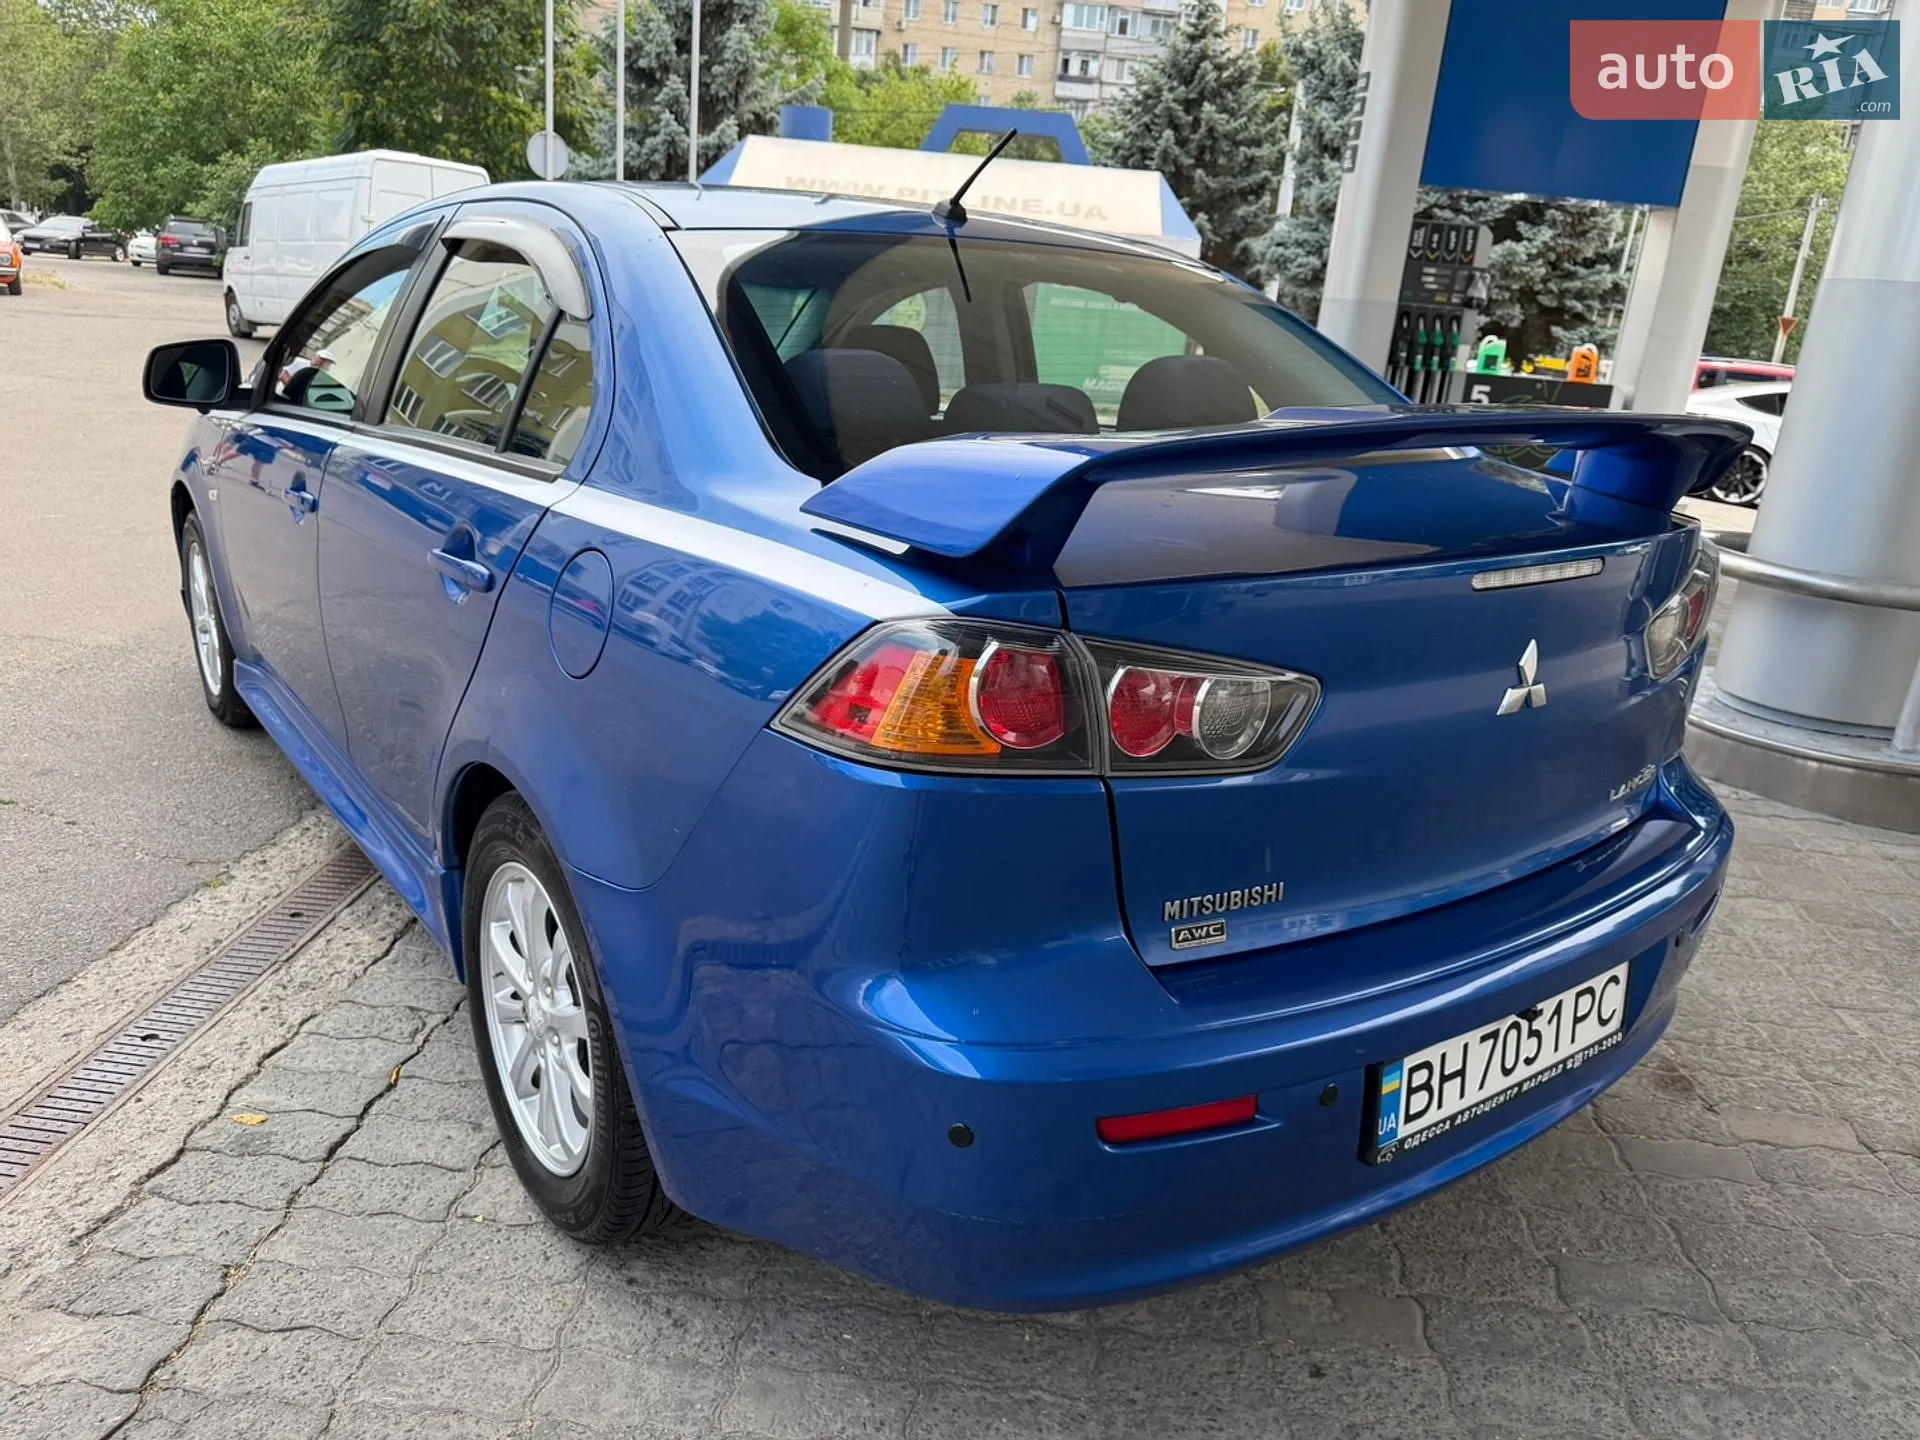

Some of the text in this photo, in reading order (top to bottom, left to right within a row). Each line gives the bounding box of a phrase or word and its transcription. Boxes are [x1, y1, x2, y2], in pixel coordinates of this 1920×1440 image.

[1470, 385, 1492, 404] 5
[1163, 882, 1285, 922] MITSUBISHI
[1178, 924, 1222, 941] AWC
[1378, 1112, 1396, 1136] UA
[1404, 1120, 1450, 1149] ОДЕССА
[1455, 1087, 1519, 1126] АВТОЦЕНТР
